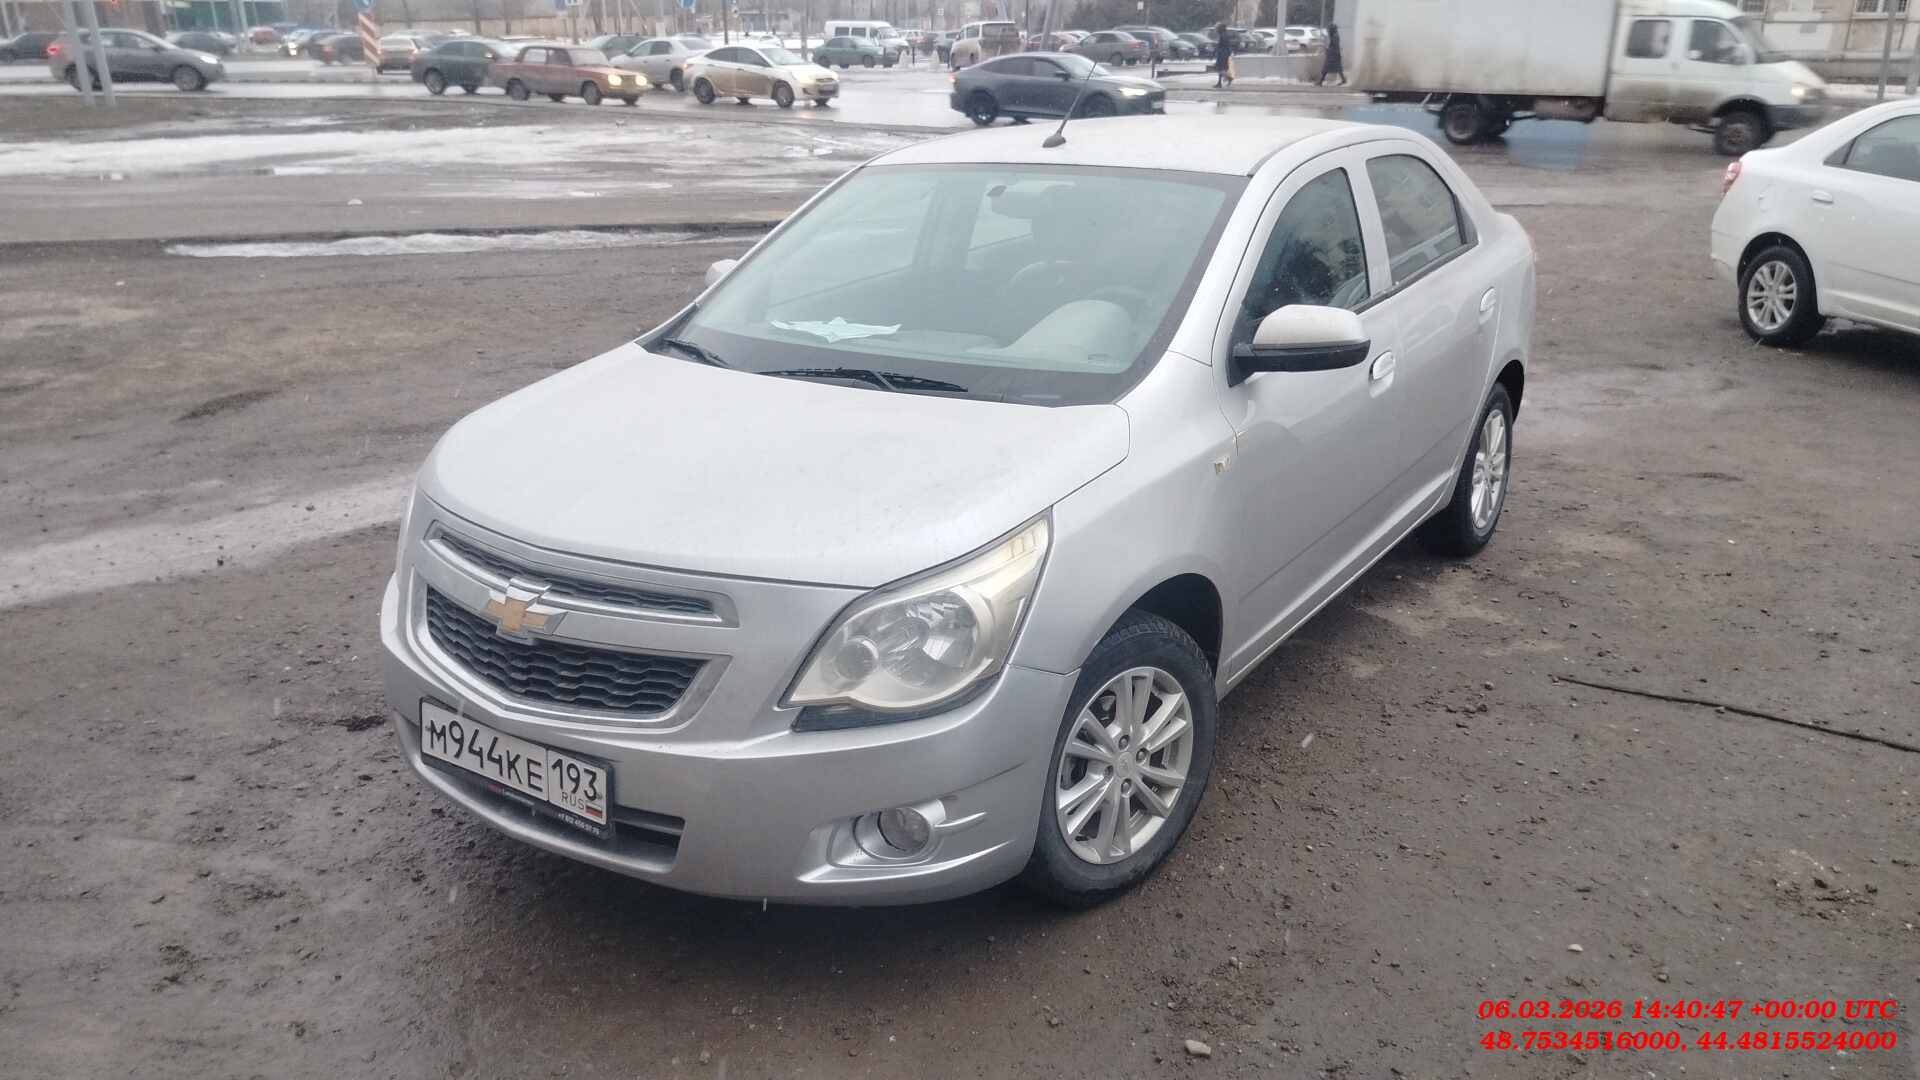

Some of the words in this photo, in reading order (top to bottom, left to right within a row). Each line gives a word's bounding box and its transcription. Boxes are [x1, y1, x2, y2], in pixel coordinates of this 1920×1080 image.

[429, 719, 544, 793] М944КЕ
[551, 758, 598, 801] 193
[561, 791, 585, 811] RUS
